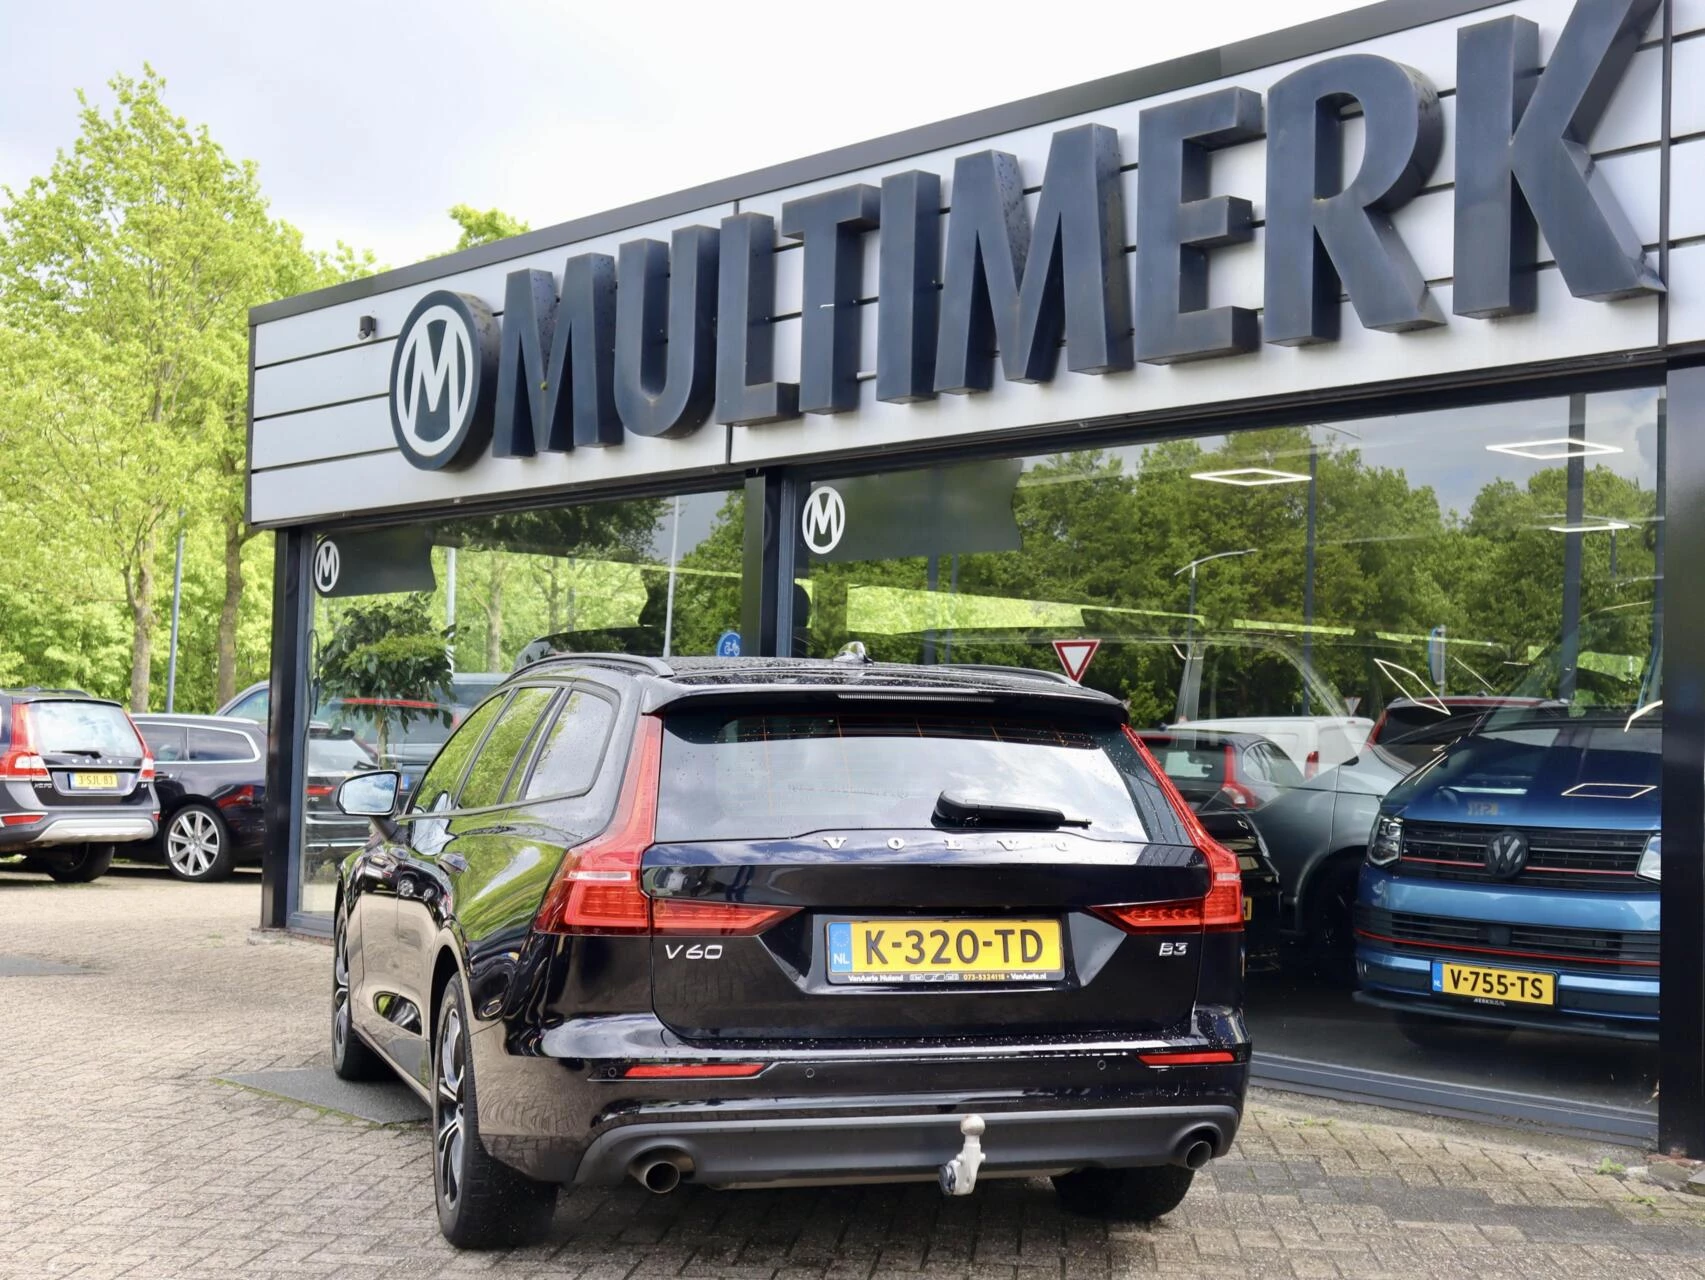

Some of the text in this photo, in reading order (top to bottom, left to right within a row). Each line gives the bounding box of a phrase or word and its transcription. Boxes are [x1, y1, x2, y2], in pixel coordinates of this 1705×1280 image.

[493, 0, 1665, 458] MULTIMERK
[823, 836, 1069, 852] VOLVO
[664, 944, 723, 960] V60
[833, 928, 1044, 965] NL K-320-TD
[1159, 942, 1188, 956] B3
[1451, 968, 1543, 1000] V-755-TS
